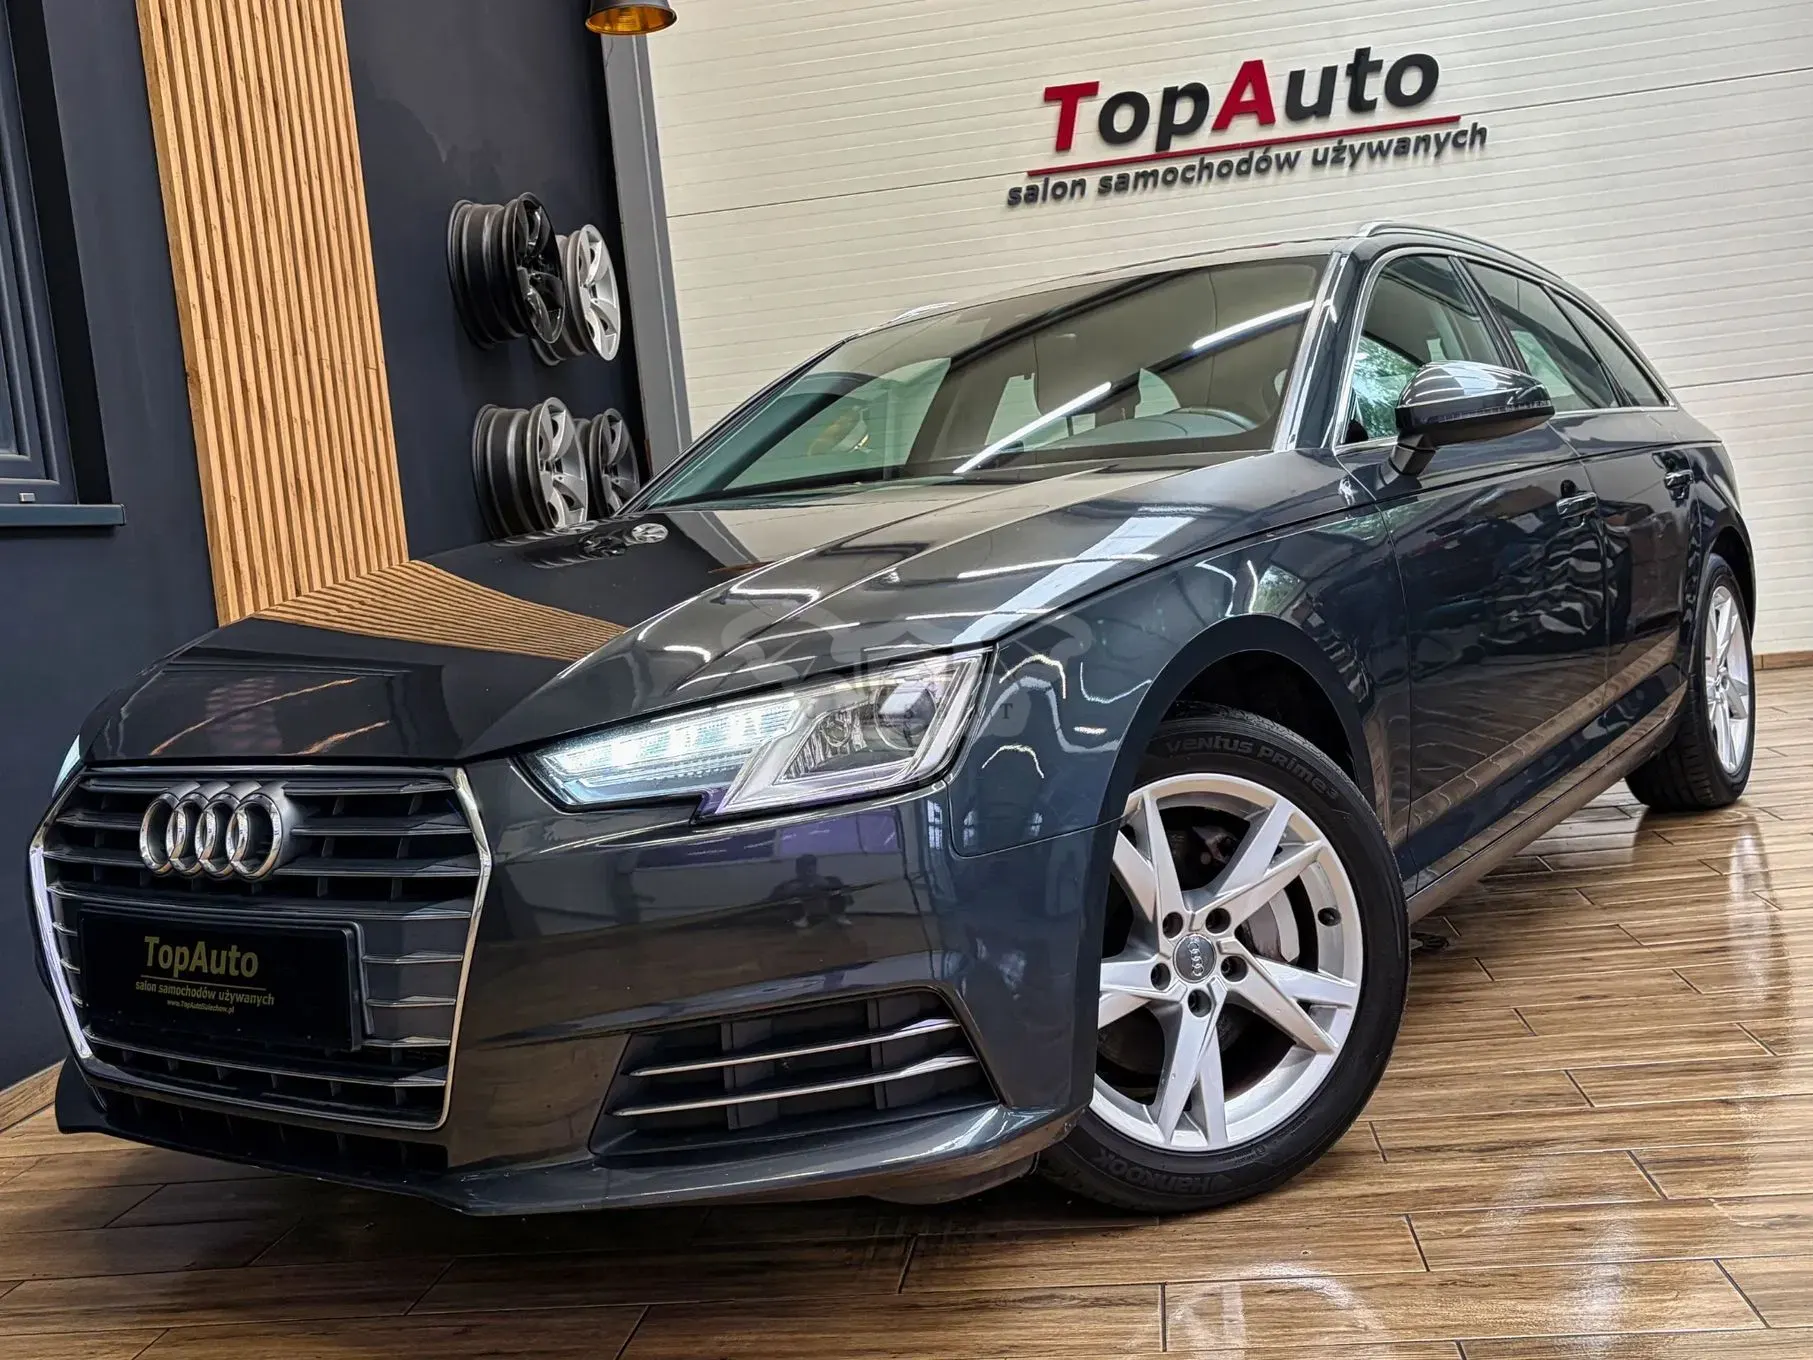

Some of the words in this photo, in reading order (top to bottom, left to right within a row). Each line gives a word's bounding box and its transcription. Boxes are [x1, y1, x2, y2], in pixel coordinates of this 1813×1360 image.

[1044, 47, 1439, 151] TopAuto
[1007, 178, 1087, 206] salon
[1099, 149, 1301, 195] samochodów
[1312, 122, 1488, 168] używanych
[144, 936, 259, 977] TopAuto
[136, 981, 157, 992] salon
[158, 985, 216, 999] samochodów
[218, 990, 275, 1007] używanych
